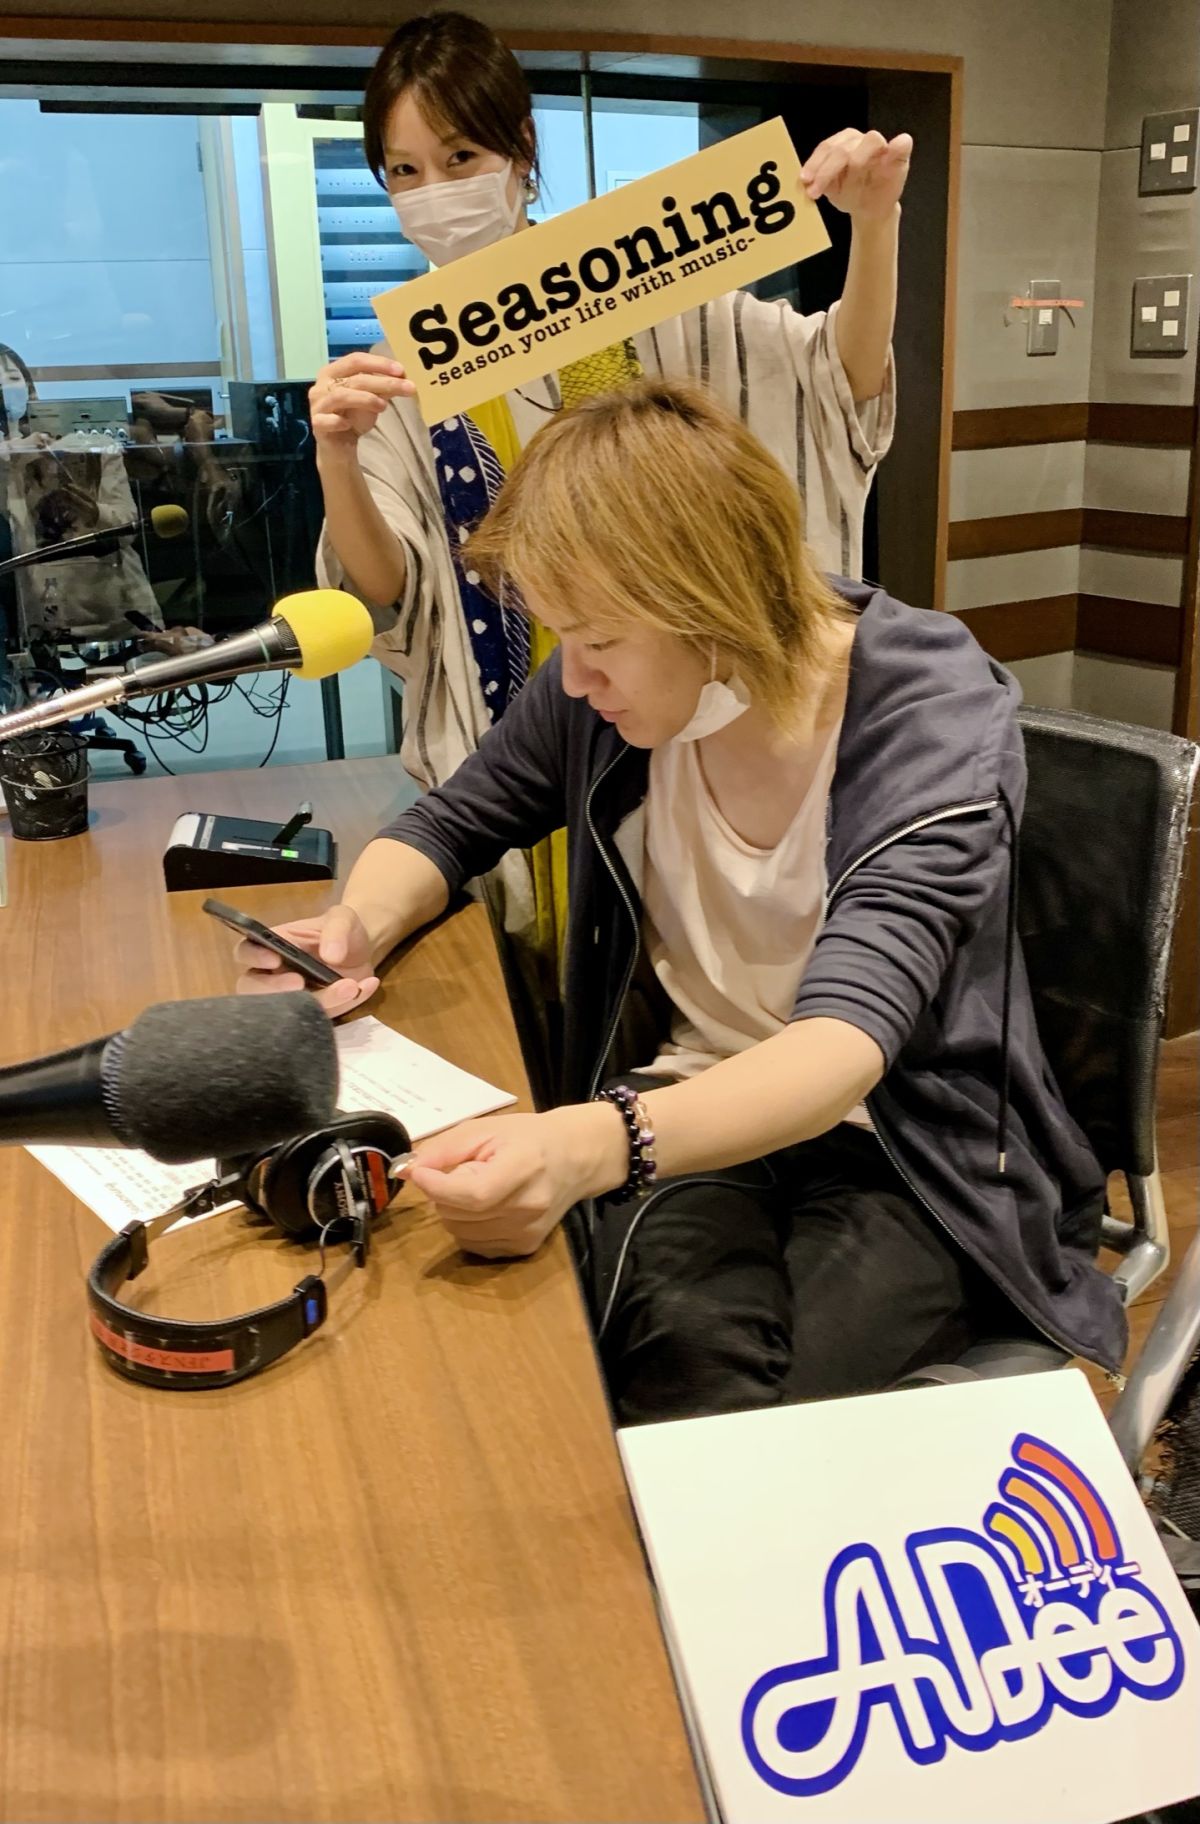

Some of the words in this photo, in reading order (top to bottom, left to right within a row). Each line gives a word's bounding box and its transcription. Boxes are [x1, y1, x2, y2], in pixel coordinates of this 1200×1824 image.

[408, 160, 796, 371] Seasoning
[430, 343, 516, 386] -season
[518, 316, 571, 354] your
[576, 297, 617, 324] life
[620, 271, 676, 303] with
[678, 237, 756, 278] music-
[1017, 1560, 1142, 1608] オーディー
